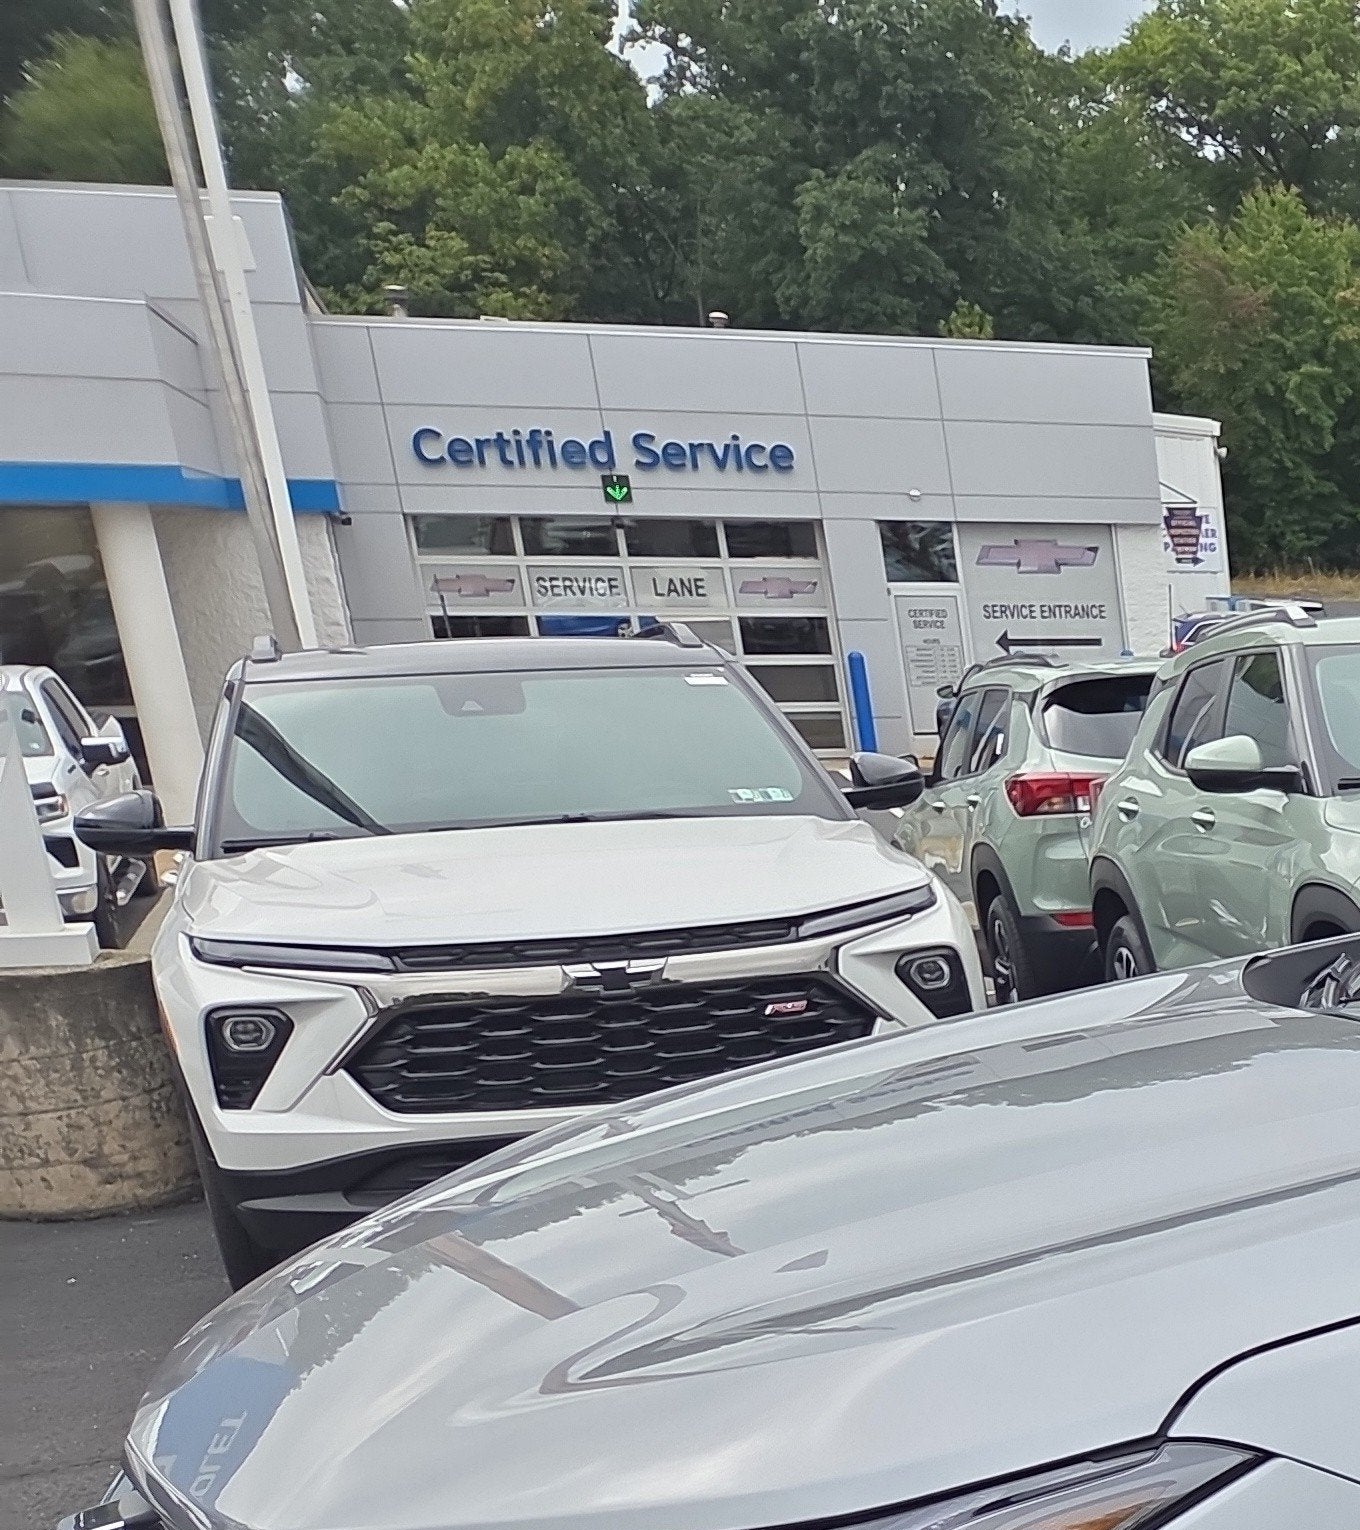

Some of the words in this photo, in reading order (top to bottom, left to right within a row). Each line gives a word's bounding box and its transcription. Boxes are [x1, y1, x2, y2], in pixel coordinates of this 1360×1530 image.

[412, 427, 617, 469] Certified
[631, 431, 796, 471] Service
[535, 576, 620, 598] SERVICE
[652, 576, 708, 598] LANE
[982, 604, 1036, 620] SERVICE
[1040, 604, 1107, 620] ENTRANCE
[912, 619, 946, 630] SERVICE
